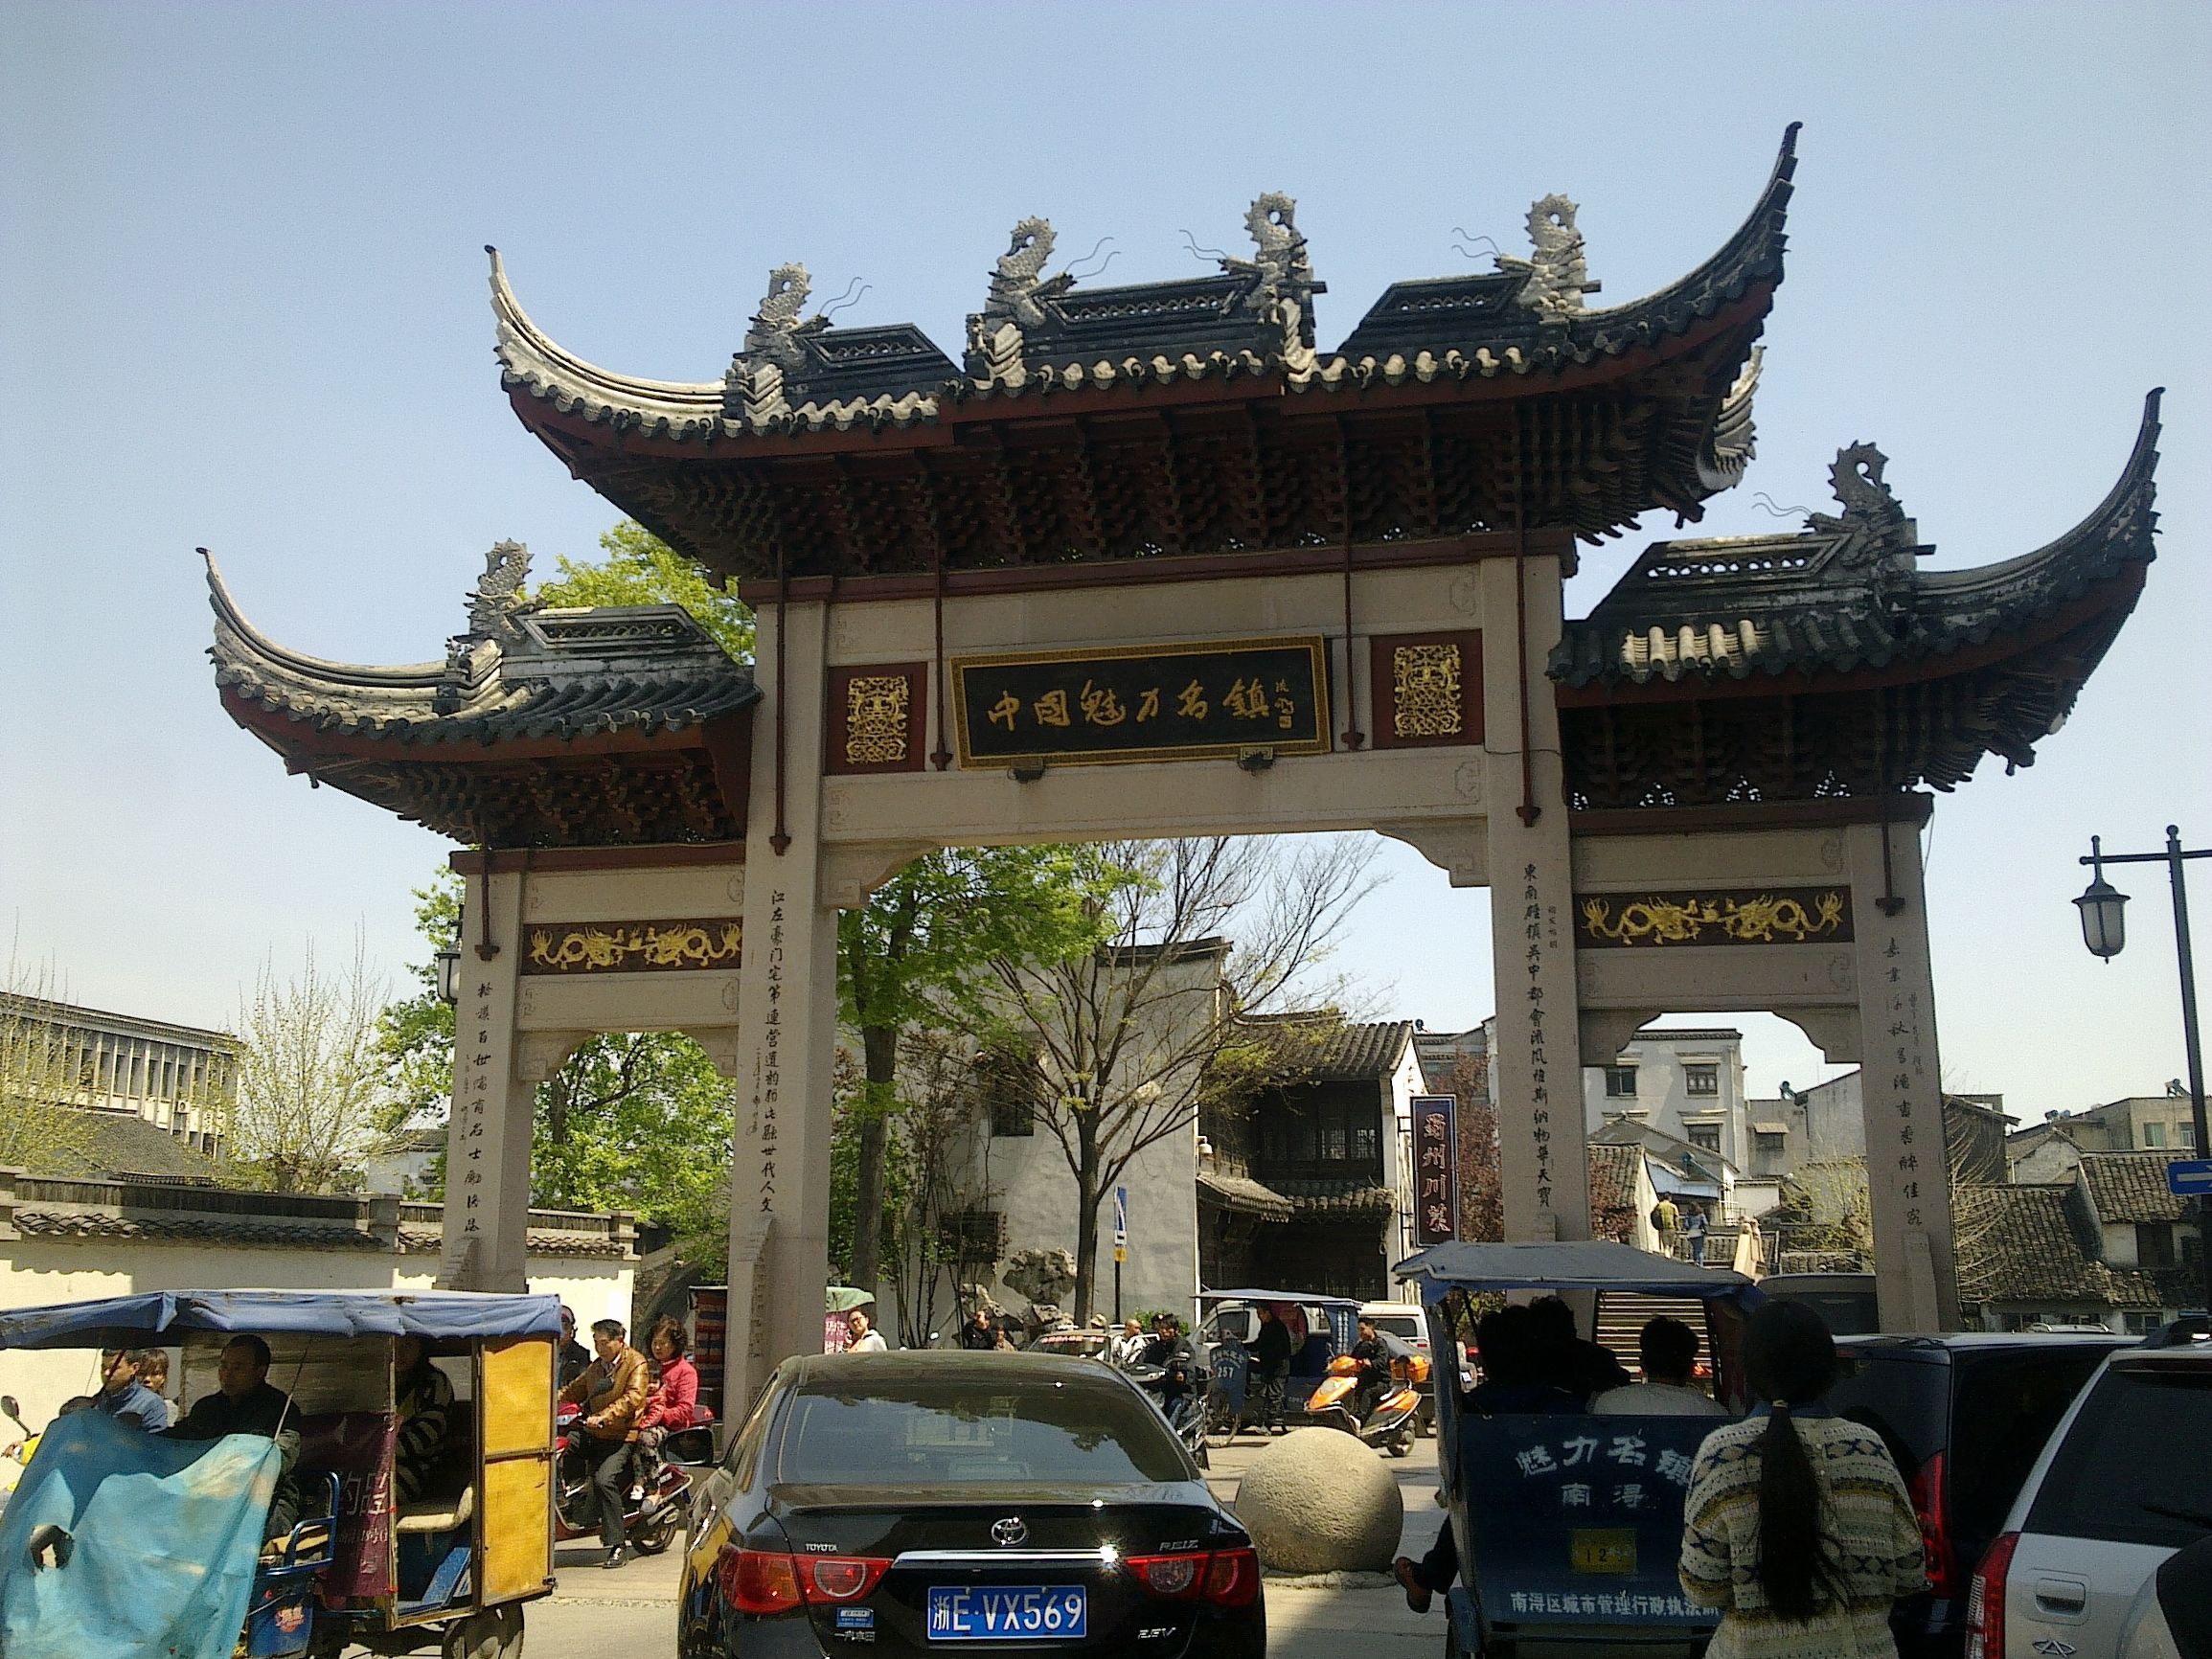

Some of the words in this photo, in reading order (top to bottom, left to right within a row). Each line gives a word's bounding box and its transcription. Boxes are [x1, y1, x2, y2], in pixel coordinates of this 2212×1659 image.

[1561, 1483, 1647, 1509] 南浔
[805, 1543, 838, 1552] TOYOTA
[1510, 1591, 1721, 1618] 南浔区城市管理行政执法
